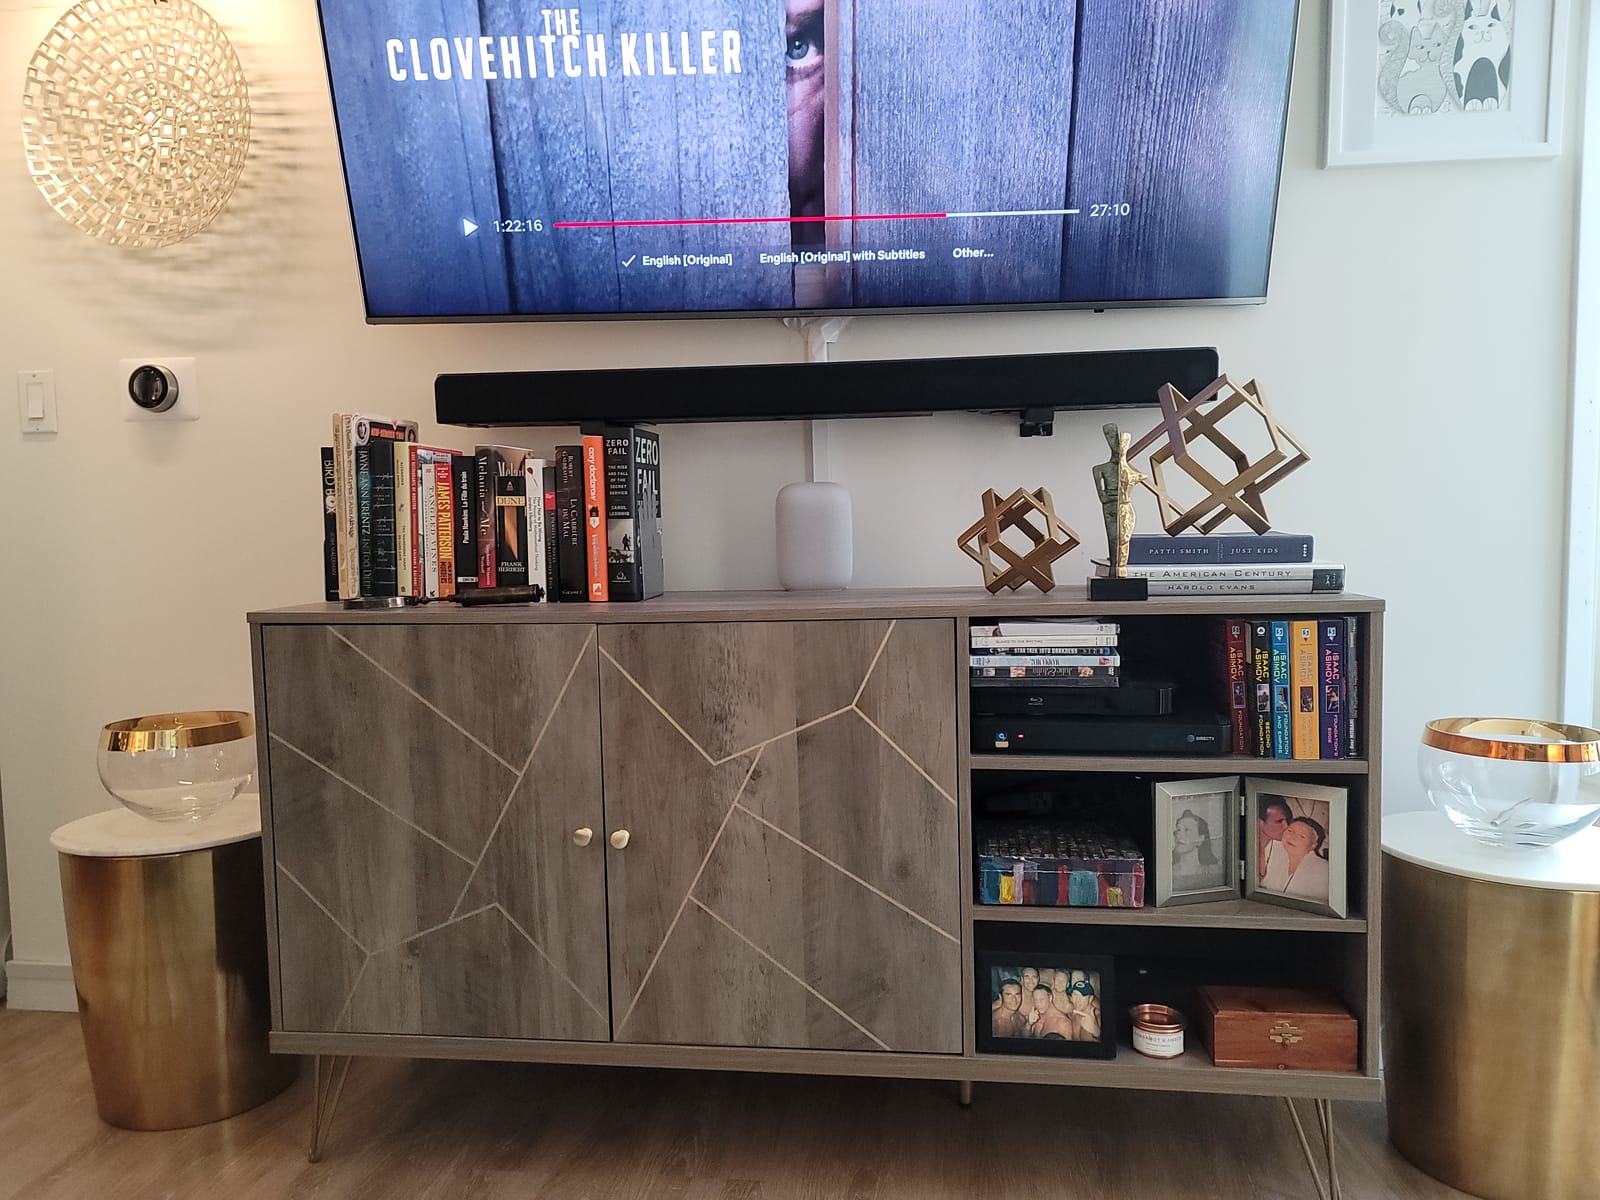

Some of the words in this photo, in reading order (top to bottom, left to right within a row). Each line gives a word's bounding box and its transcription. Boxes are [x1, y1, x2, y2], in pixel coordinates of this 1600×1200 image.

[541, 8, 581, 36] THE
[385, 33, 608, 82] CLOVEHITCH
[620, 29, 743, 77] KILLER
[1089, 203, 1131, 218] 27:10
[492, 219, 544, 233] 1:22:16
[642, 254, 682, 268] English
[683, 253, 733, 267] [Original]
[759, 252, 799, 266] English
[800, 250, 851, 265] [Original]
[852, 249, 877, 262] with
[877, 247, 926, 261] Subtitles
[952, 246, 995, 260] Other...
[588, 447, 596, 464] cory
[606, 440, 629, 448] ZERO
[635, 436, 659, 466] ZERO
[323, 459, 335, 484] BIRD
[358, 449, 369, 476] JAYNE
[497, 461, 525, 477] Melan
[359, 477, 369, 498] ANN
[478, 456, 488, 498] Melania
[589, 464, 598, 500] doctorow
[636, 468, 659, 496] FAIL
[325, 486, 337, 514] BOX
[437, 482, 450, 512] JAMES
[570, 498, 578, 508] LA
[360, 500, 371, 535] KRENTZ
[428, 486, 436, 536] TANGLED
[562, 508, 568, 520] DU
[438, 512, 452, 559] PATTERSON
[462, 530, 470, 544] Paula
[480, 518, 490, 536] Me
[1162, 570, 1226, 578] AMERICAN
[1234, 570, 1292, 578] CENTURY
[1230, 647, 1238, 680] ASIMOV
